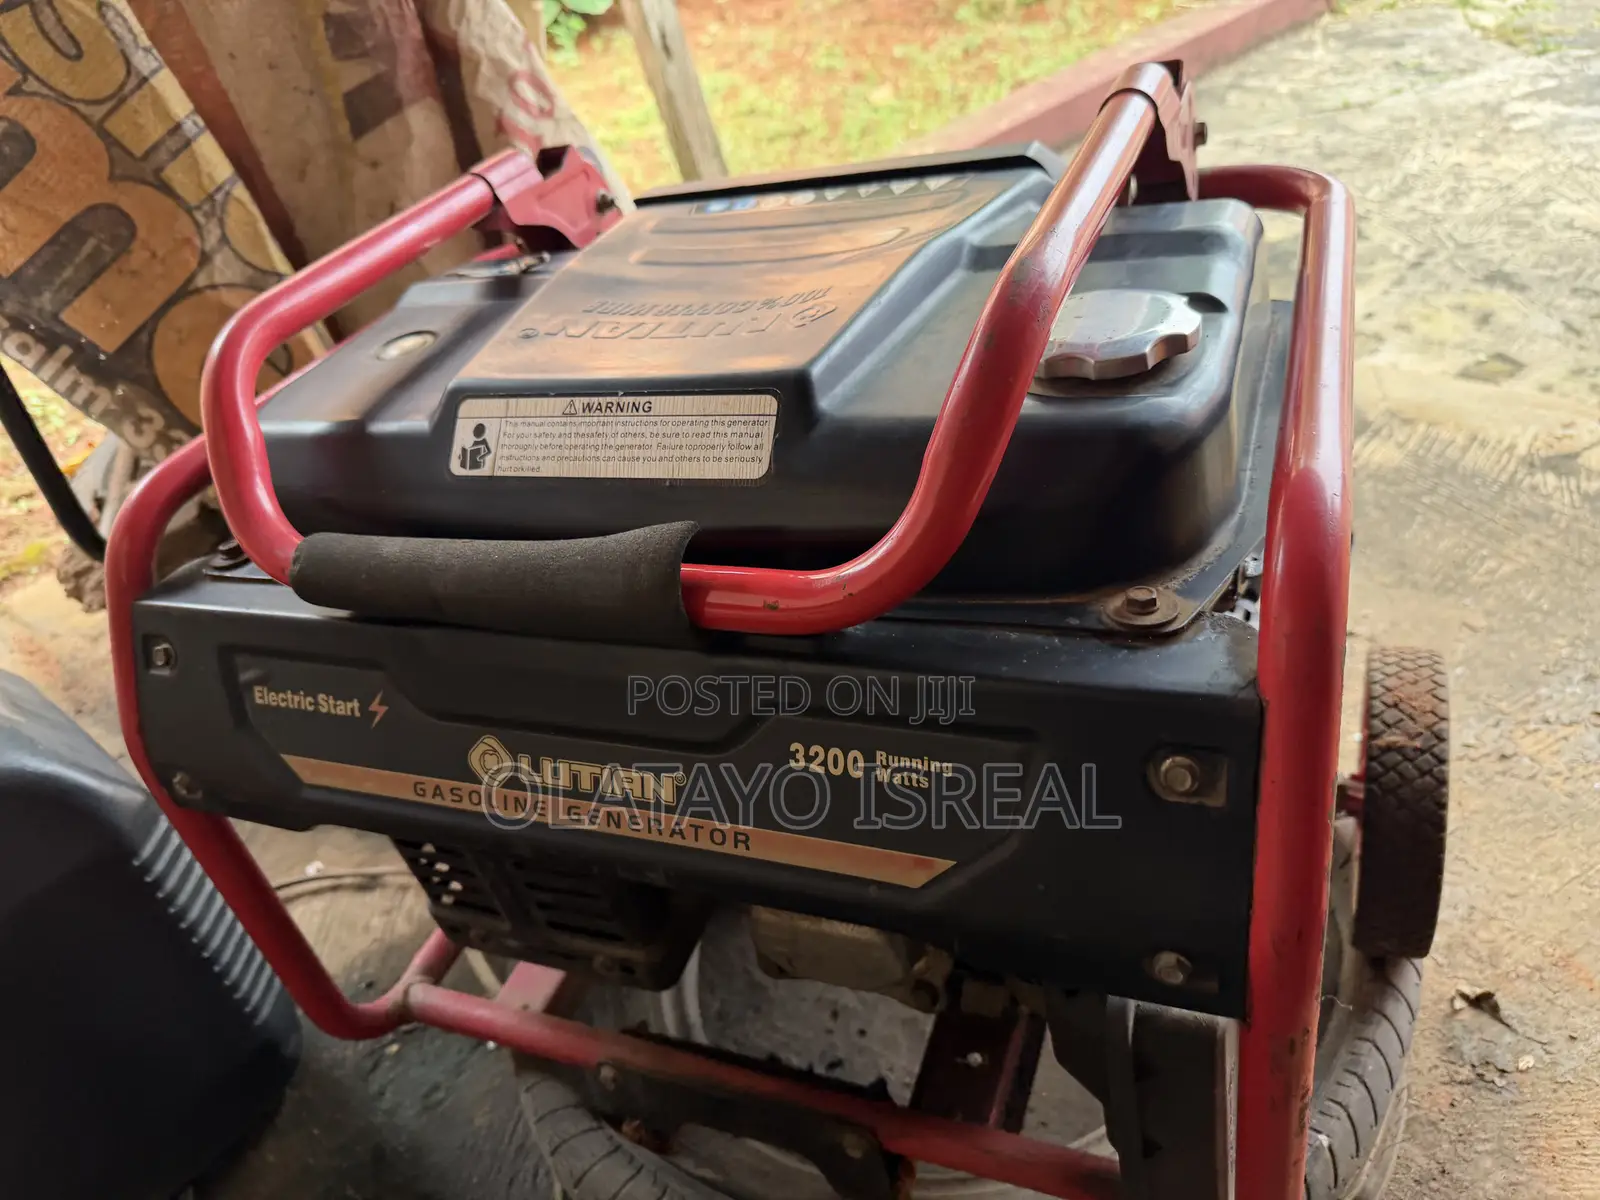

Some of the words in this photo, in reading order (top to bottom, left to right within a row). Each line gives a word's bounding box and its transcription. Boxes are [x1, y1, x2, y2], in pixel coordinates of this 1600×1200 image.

[581, 401, 652, 414] WARNING
[671, 420, 710, 428] operating
[516, 431, 532, 440] your
[534, 431, 556, 440] safety
[620, 431, 648, 440] others,
[501, 443, 538, 452] thoroughly
[564, 443, 600, 452] operating
[556, 455, 600, 464] precautions
[724, 456, 763, 464] seriously
[253, 685, 315, 712] Electric
[317, 693, 361, 717] Start
[789, 742, 864, 779] 3200
[876, 750, 953, 777] Running
[876, 767, 929, 789] Watts
[413, 781, 548, 817] GASOLINE
[566, 805, 751, 852] GENERATOR
